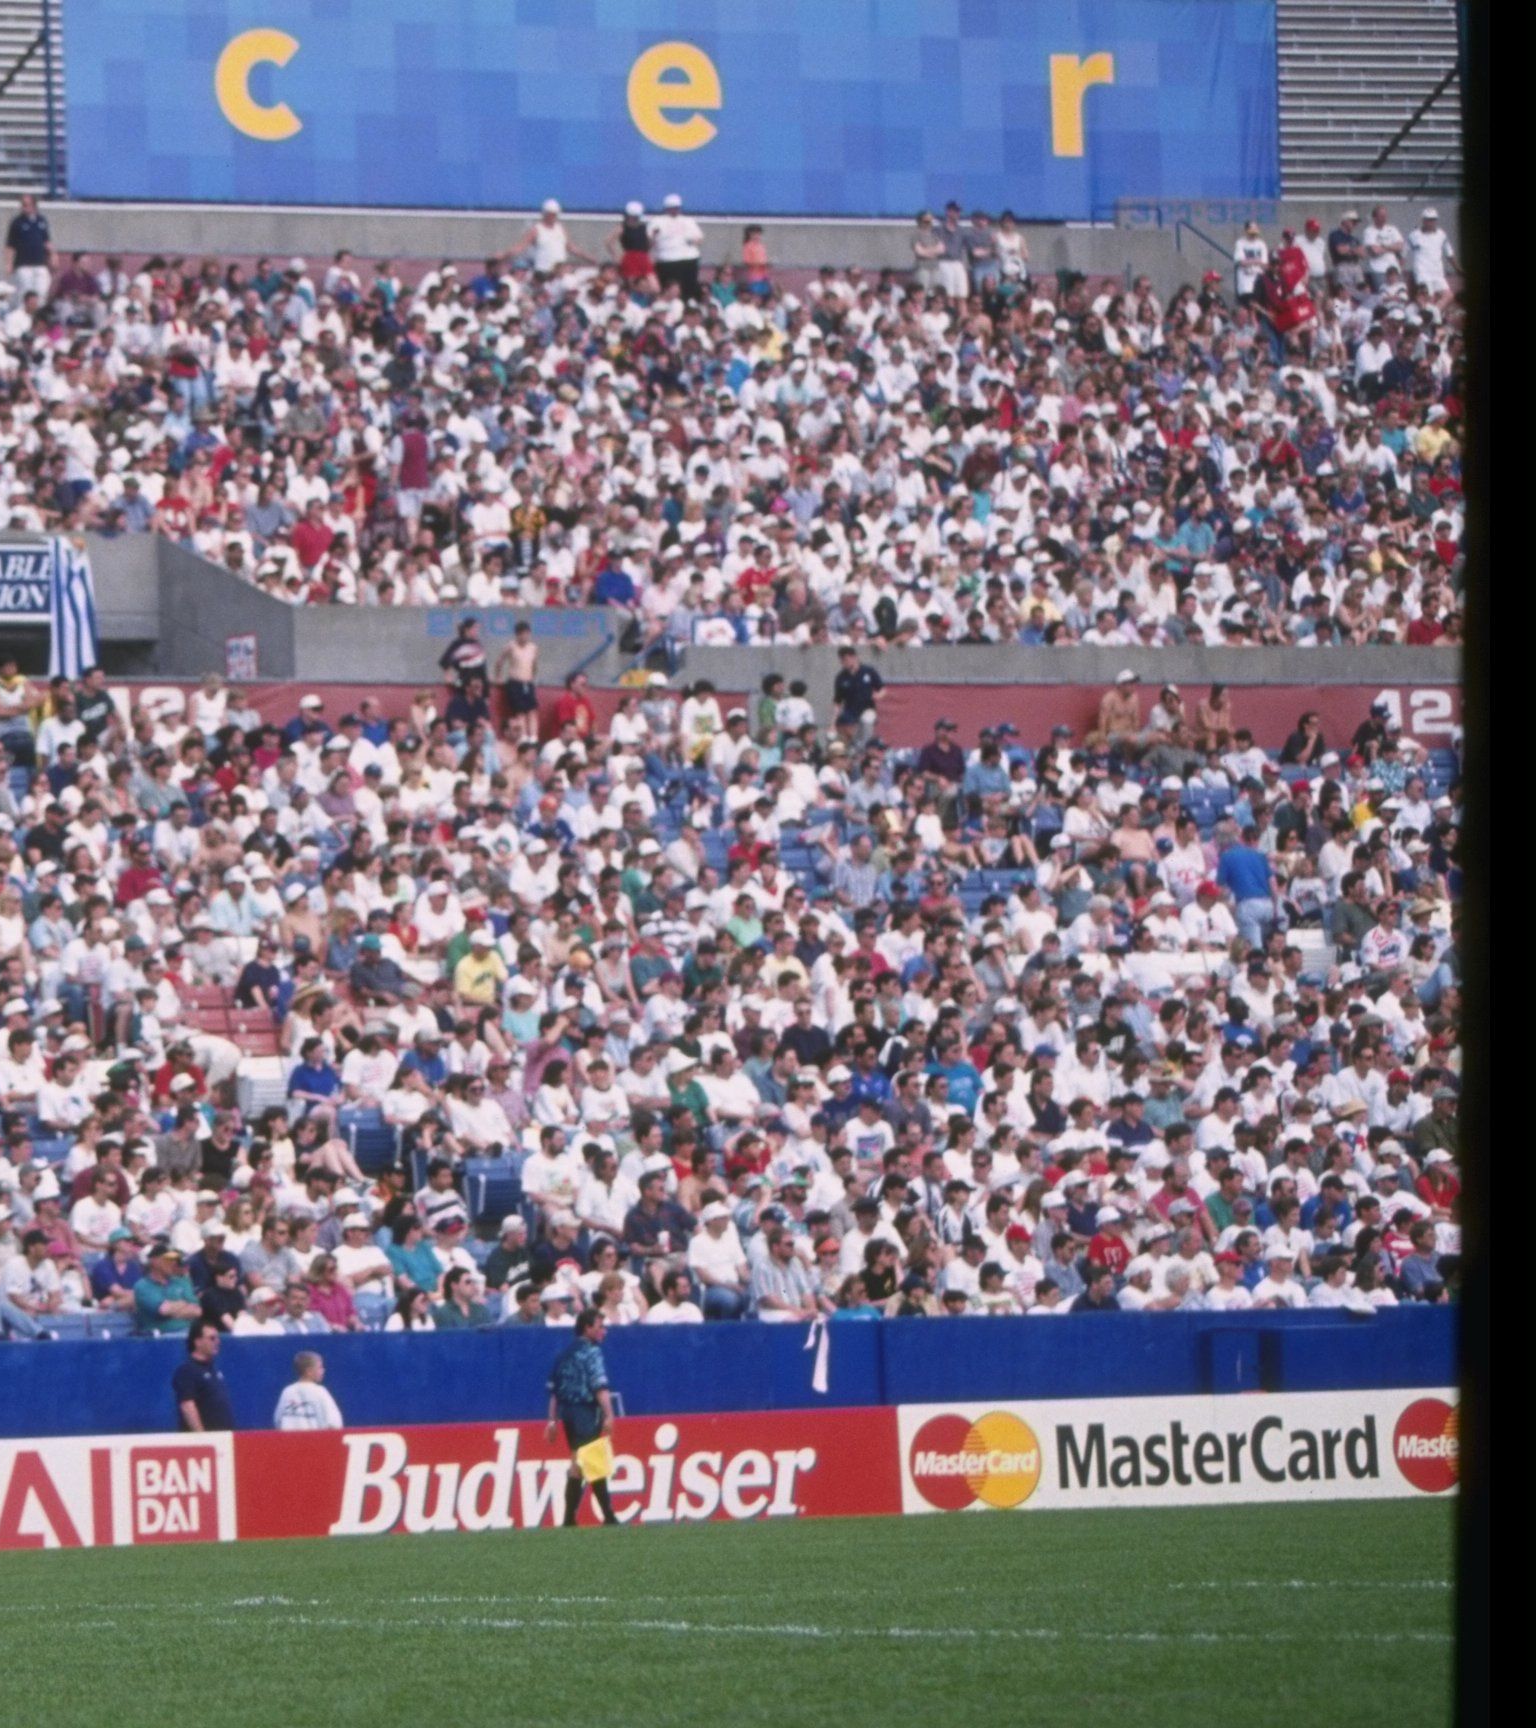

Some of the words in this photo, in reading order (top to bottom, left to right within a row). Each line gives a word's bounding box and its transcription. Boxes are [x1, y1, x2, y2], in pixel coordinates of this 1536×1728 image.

[914, 1447, 1037, 1477] MasterCard
[1055, 1413, 1380, 1491] MasterCard
[135, 1456, 212, 1496] BAN
[329, 1422, 817, 1537] Budweiser
[136, 1496, 201, 1534] DAI
